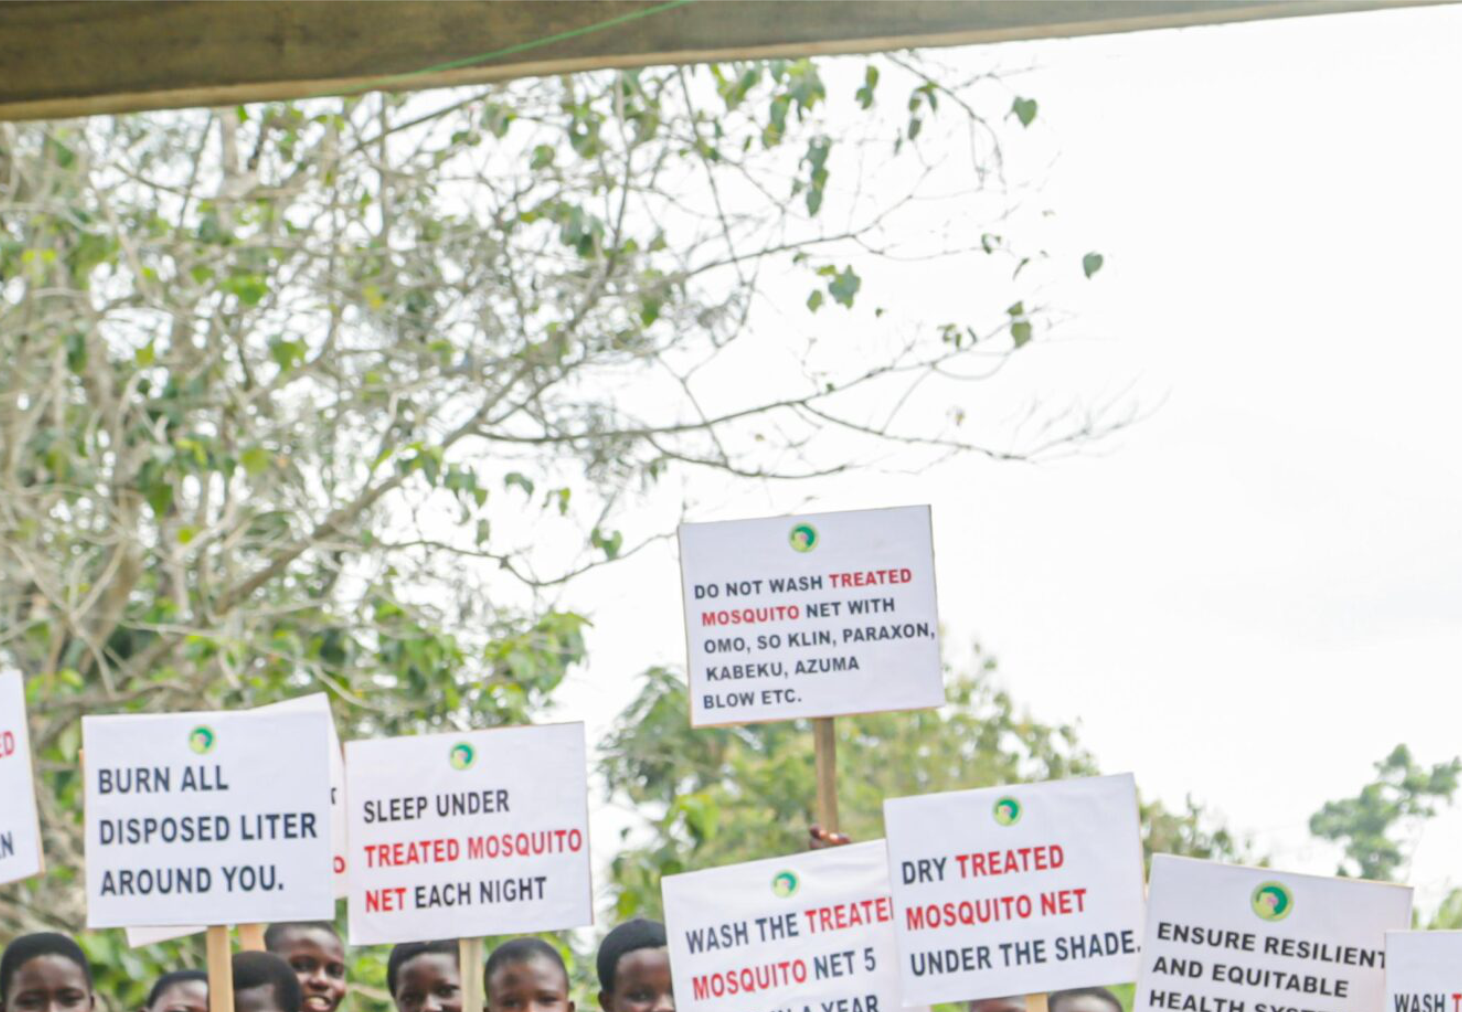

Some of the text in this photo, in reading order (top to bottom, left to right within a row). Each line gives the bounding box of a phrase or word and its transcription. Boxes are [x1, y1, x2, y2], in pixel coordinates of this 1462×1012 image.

[693, 567, 913, 600] DO NOT WASH TREATED
[701, 597, 895, 627] MOSQUITO NET WITH
[703, 622, 936, 655] OMO, SO KLIN, PARAXON,
[705, 655, 860, 682] KABEKU, AZUMA
[702, 688, 802, 710] BLOW ETC.
[98, 764, 230, 795] BURN ALL
[363, 795, 429, 825] SLEEP
[435, 788, 510, 818] UNDER
[99, 811, 318, 846] DISPOSED LITER
[363, 837, 461, 869] TREATED
[467, 828, 583, 860] MOSQUITO
[901, 843, 1065, 886] DRY TREATED
[100, 864, 284, 897] AROUND YOU.
[365, 875, 548, 914] NET EACH NIGHT
[685, 896, 894, 955] WASH THE TREATE
[905, 887, 1087, 931] MOSQUITO NET
[910, 929, 1141, 977] UNDER THE SHADE.
[1156, 921, 1256, 952] ENSURE
[691, 946, 877, 1001] MOSQUITO NET 5
[1152, 955, 1349, 999] AND EQUITABLE
